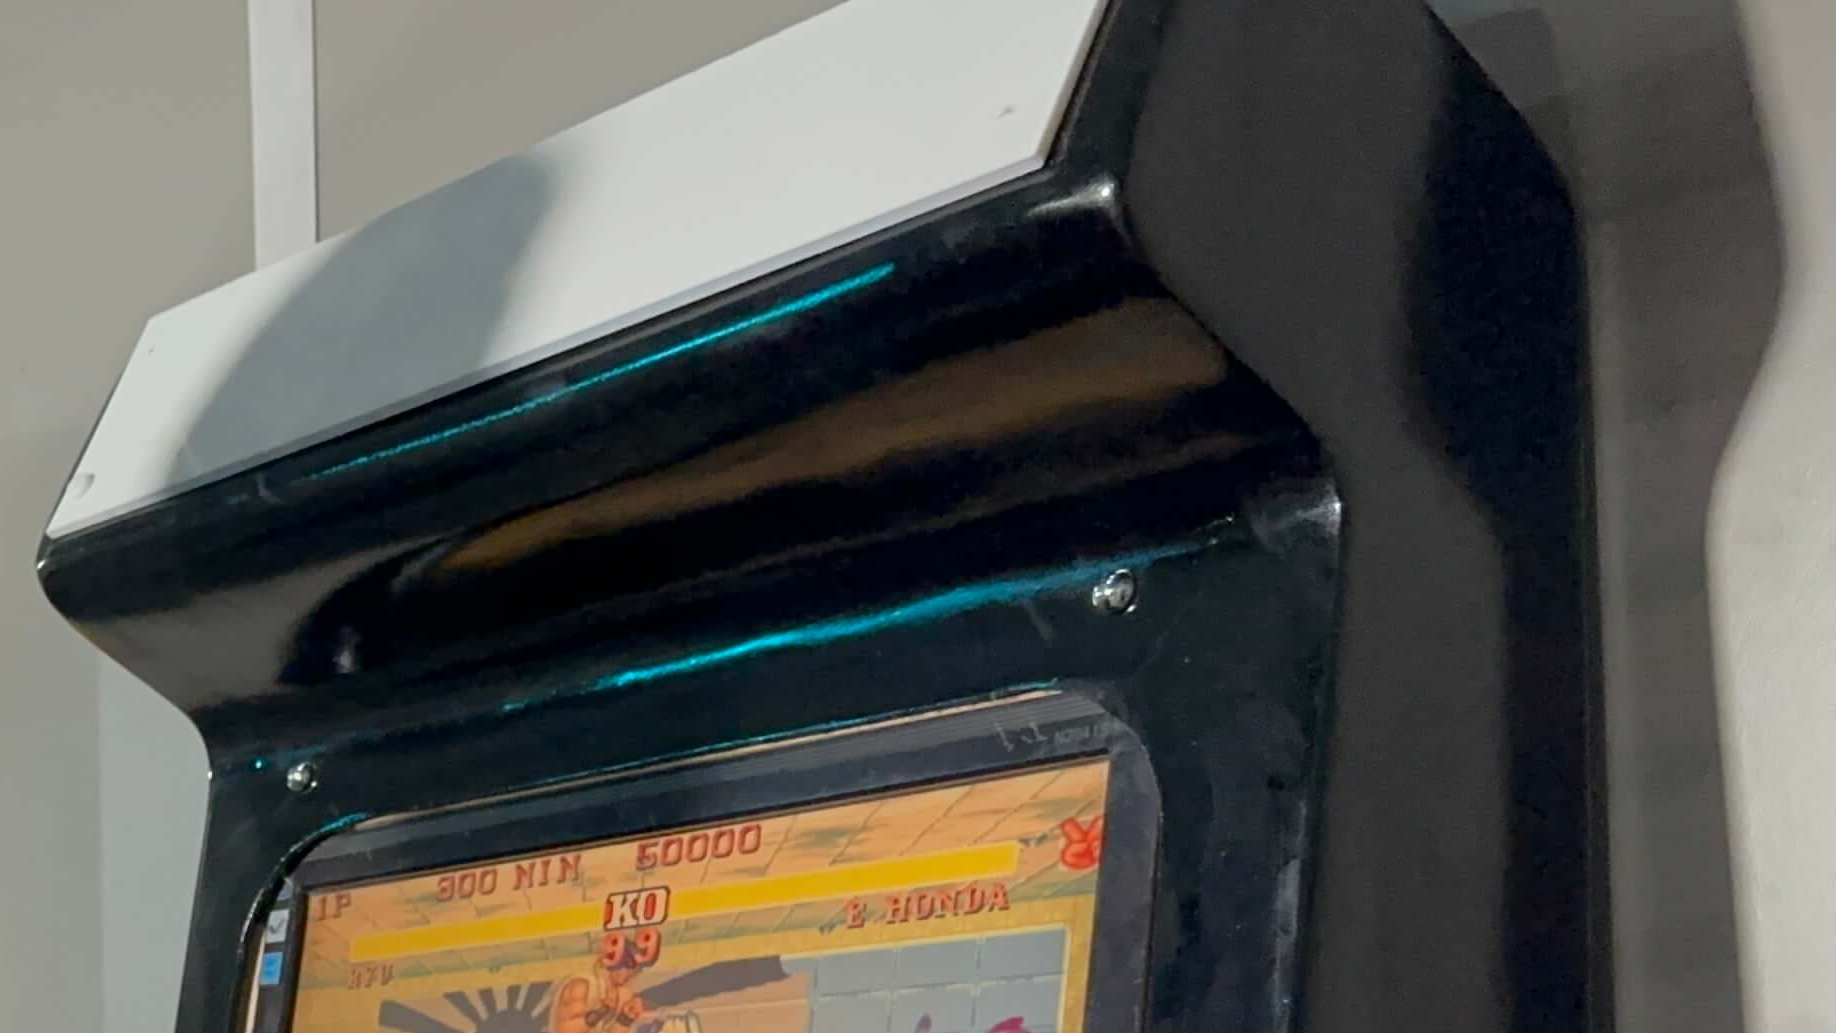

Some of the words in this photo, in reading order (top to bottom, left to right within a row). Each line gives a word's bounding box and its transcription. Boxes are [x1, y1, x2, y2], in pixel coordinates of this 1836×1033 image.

[635, 823, 762, 871] 50000
[604, 887, 669, 931] KO
[885, 880, 1011, 925] HONDA
[602, 926, 662, 969] 99
